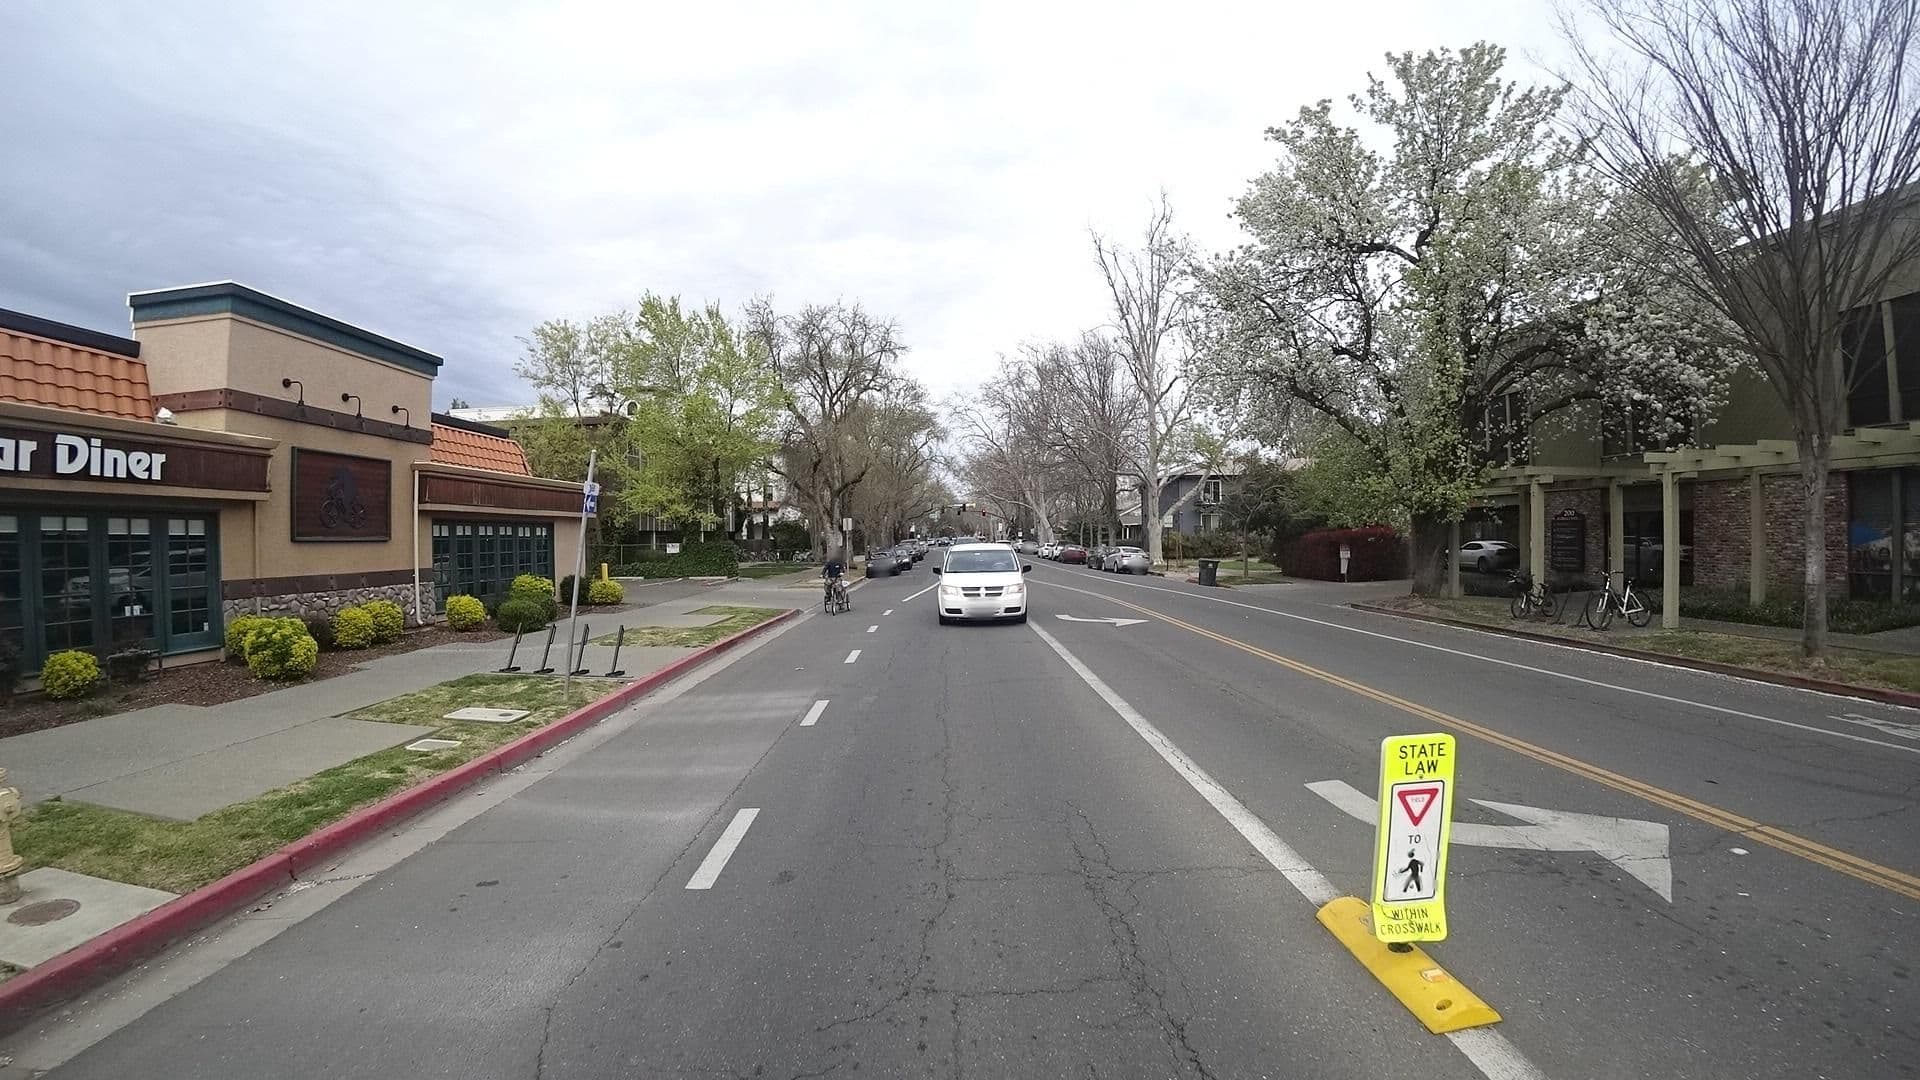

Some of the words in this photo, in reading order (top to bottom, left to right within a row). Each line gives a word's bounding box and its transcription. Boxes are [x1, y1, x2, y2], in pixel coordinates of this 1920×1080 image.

[55, 434, 166, 480] Diner
[1399, 743, 1446, 759] STATE
[1405, 760, 1438, 775] LAW
[1408, 834, 1421, 844] TO
[1391, 907, 1428, 920] WITHIN
[1380, 922, 1441, 935] CROSSWALK
